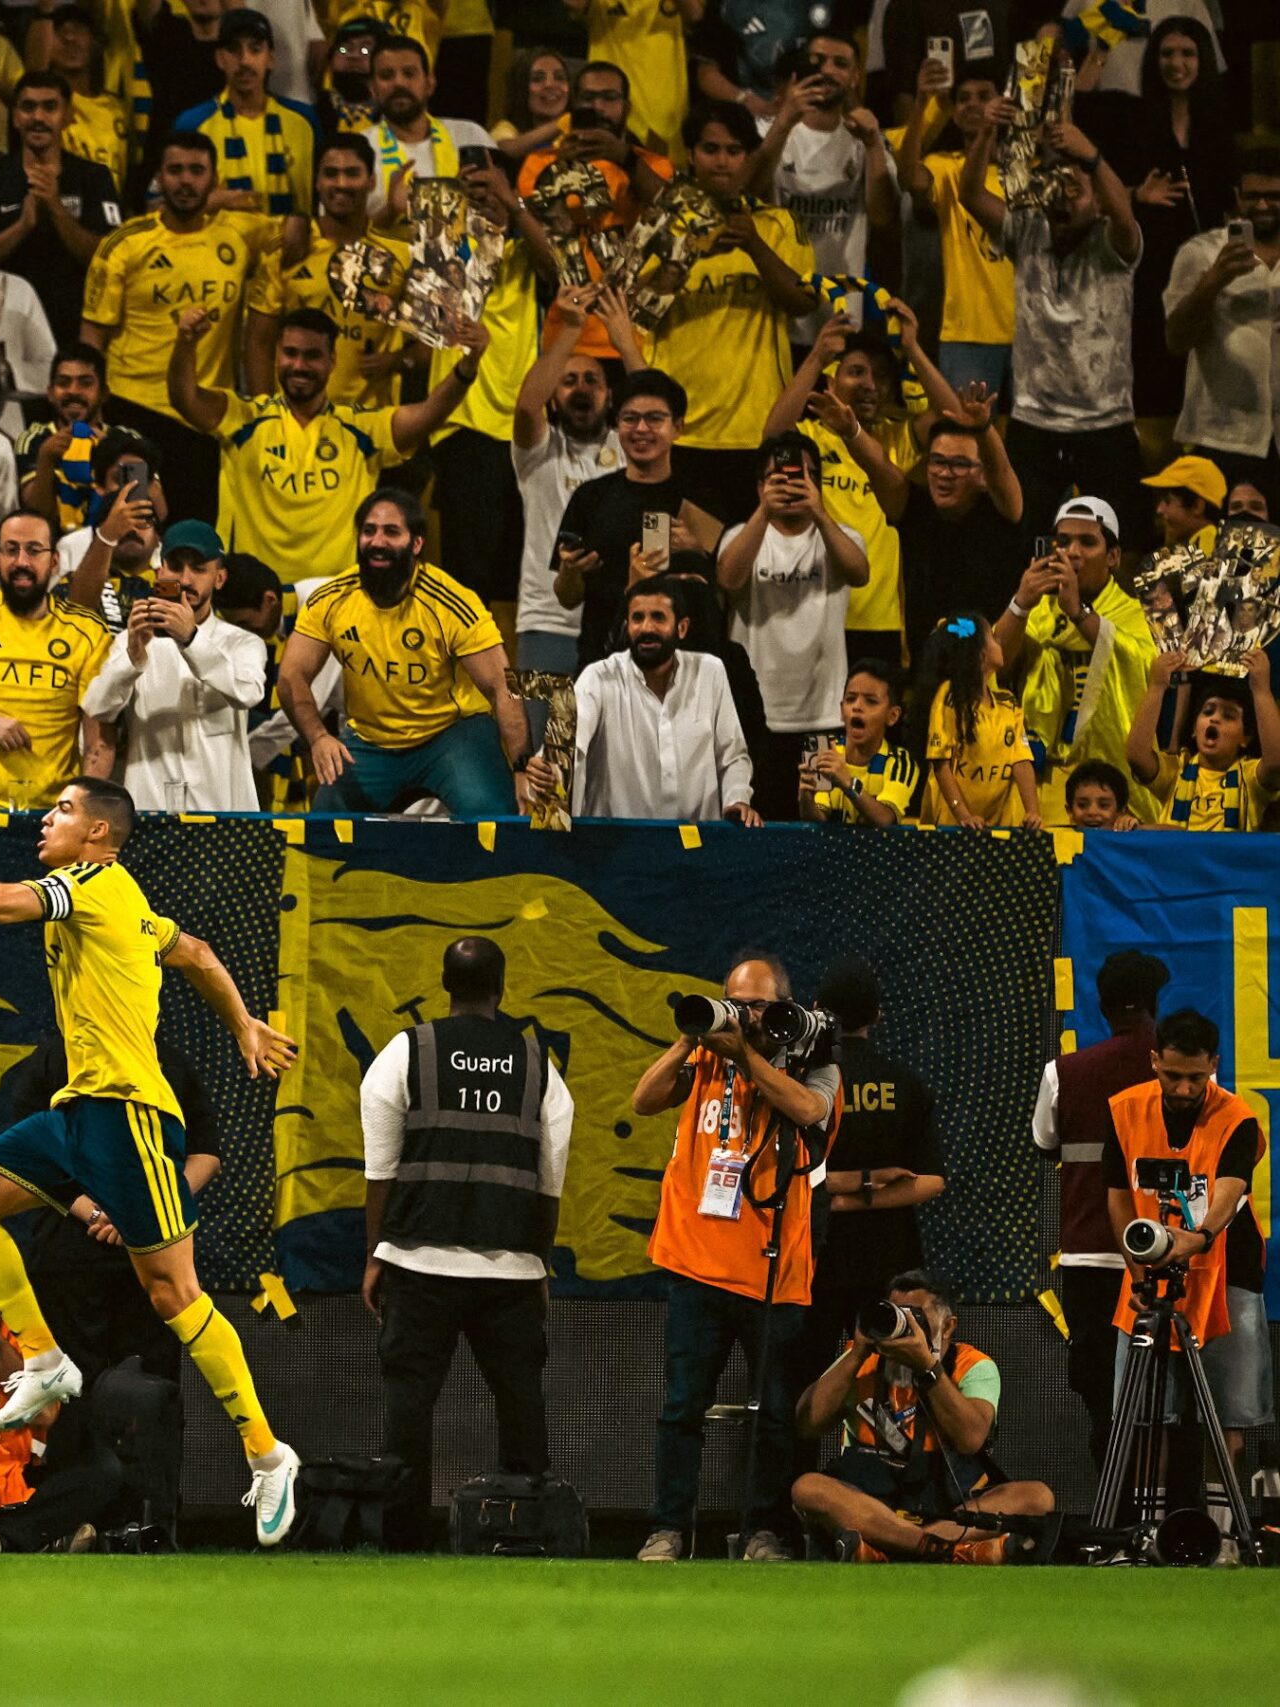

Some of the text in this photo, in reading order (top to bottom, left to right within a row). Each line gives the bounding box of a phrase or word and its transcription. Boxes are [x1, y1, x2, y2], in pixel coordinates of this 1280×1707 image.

[152, 280, 238, 304] KAFD
[261, 464, 340, 495] KAFD
[340, 649, 427, 685] KAFD
[450, 1050, 514, 1075] Guard
[458, 1087, 502, 1113] 110
